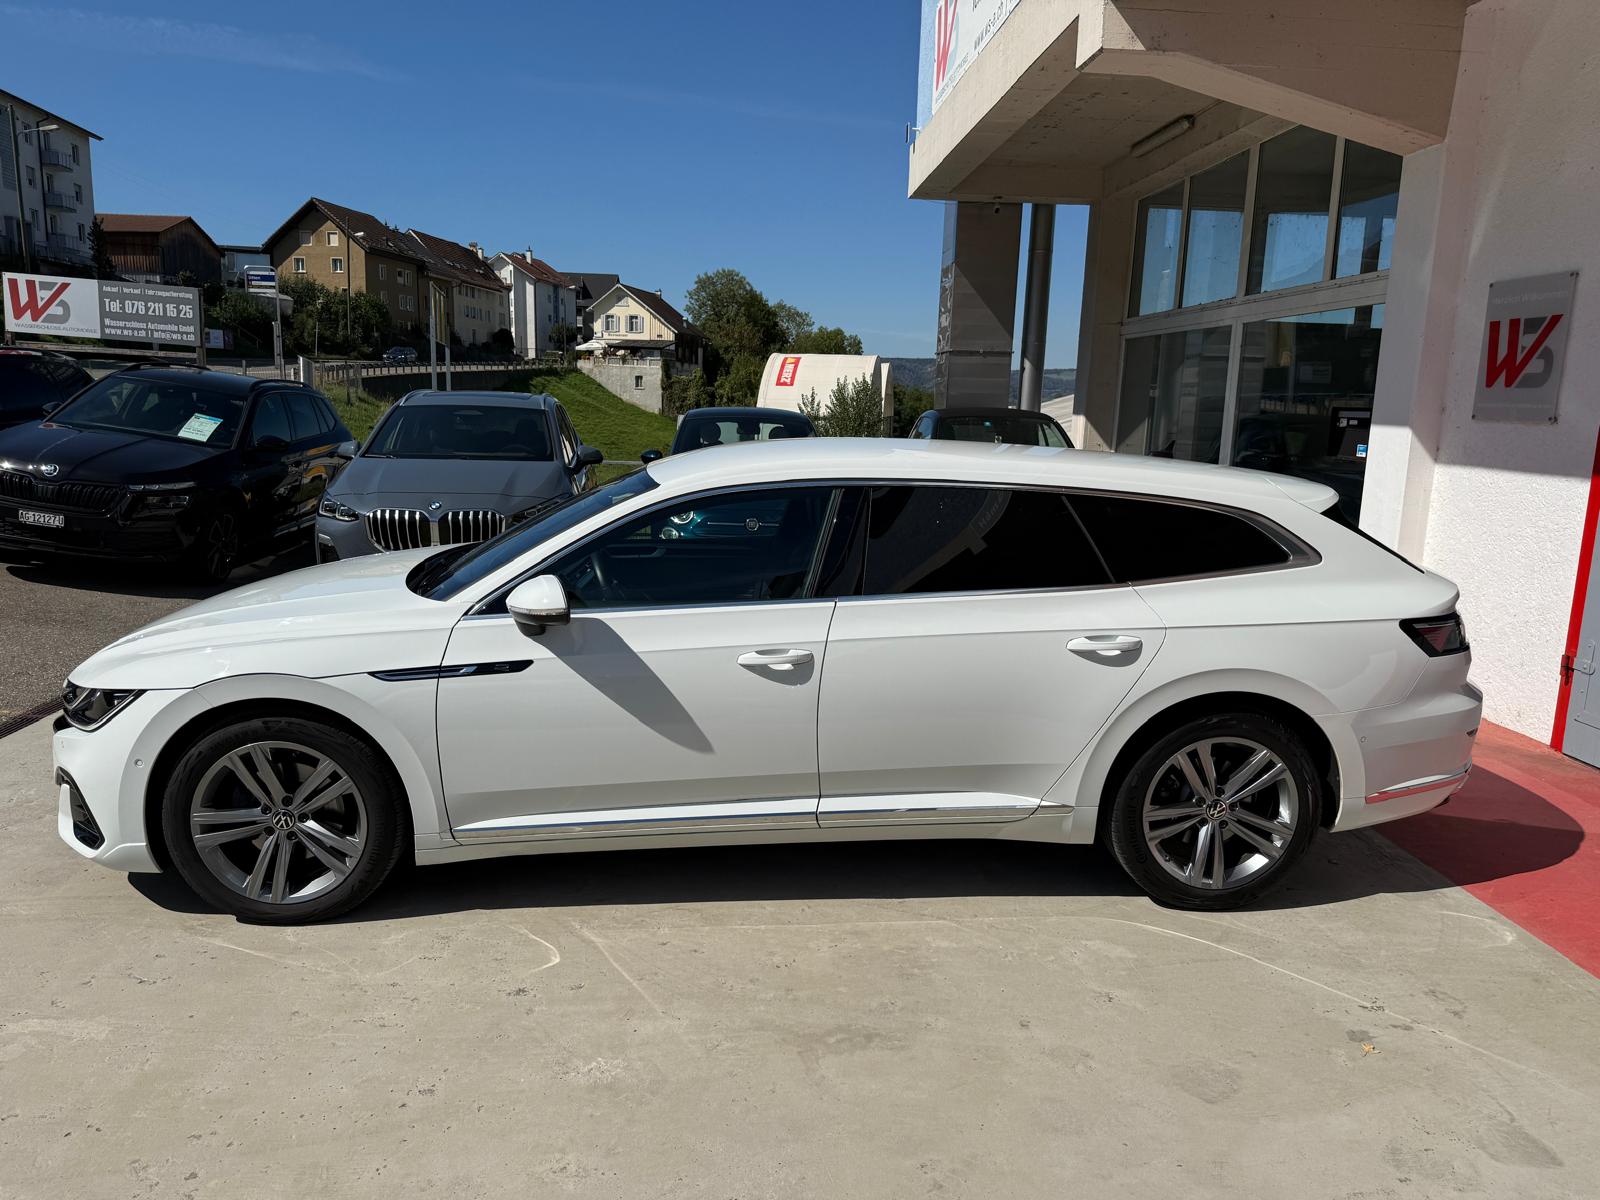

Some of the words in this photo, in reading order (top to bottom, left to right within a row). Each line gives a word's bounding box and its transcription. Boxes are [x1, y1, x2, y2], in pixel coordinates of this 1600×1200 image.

[104, 298, 123, 313] Tel:
[125, 300, 145, 315] 076
[147, 302, 163, 316] 211
[166, 303, 177, 317] 15
[179, 304, 193, 318] 25
[104, 317, 147, 329] Wasserschloss
[147, 321, 179, 331] Automobile
[104, 327, 146, 337] www.ws-a.ch
[153, 330, 195, 341] info@ws-a.ch
[780, 363, 796, 384] MERZ
